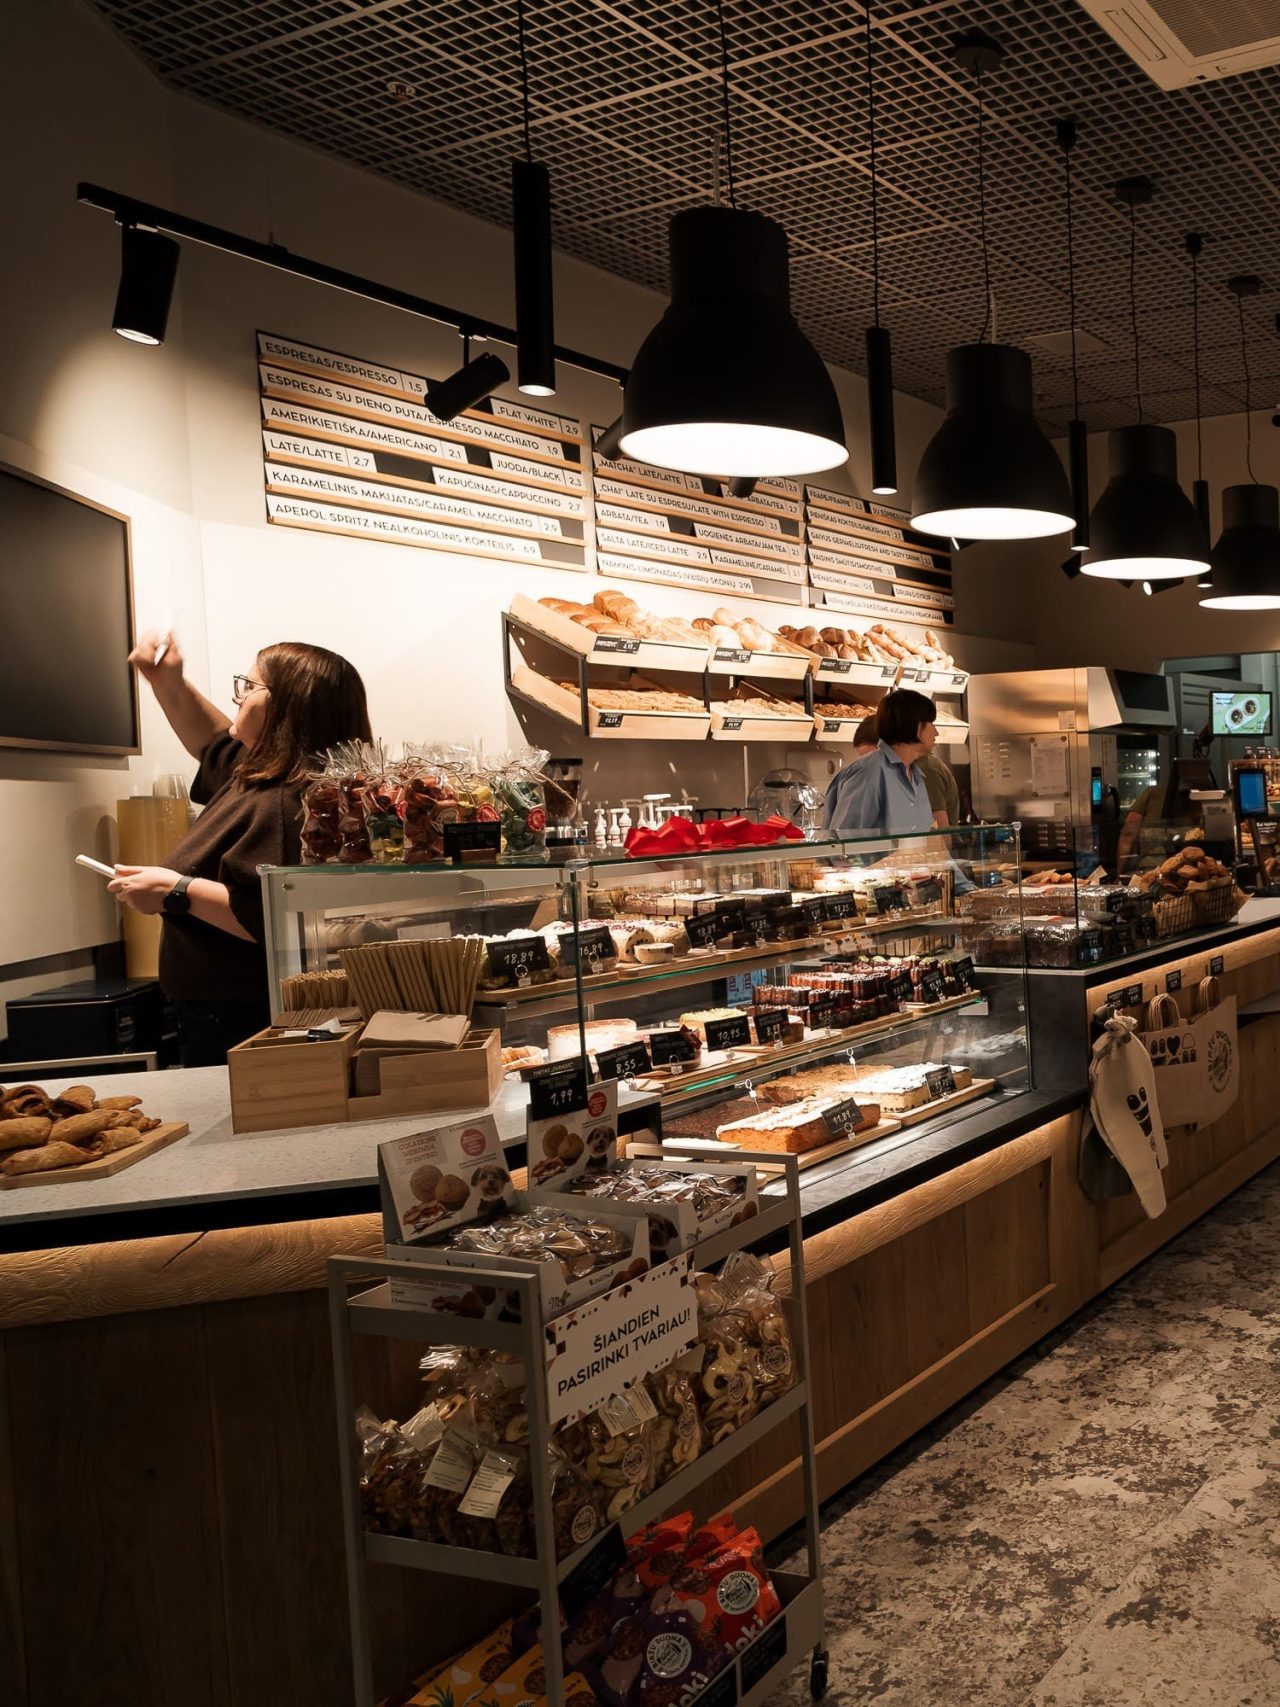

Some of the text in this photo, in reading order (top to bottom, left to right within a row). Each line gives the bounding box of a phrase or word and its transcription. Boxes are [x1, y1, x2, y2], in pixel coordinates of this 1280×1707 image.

[264, 342, 398, 385] ESPRESAS/ESPRESSO
[266, 373, 334, 398] ESPRESAS
[336, 391, 352, 403] SU
[355, 395, 392, 412] PIENO
[484, 429, 540, 450] MACCHIATO
[497, 458, 562, 483] JUODA/BLACK
[272, 471, 358, 496] KARAMELINIS
[275, 504, 328, 521] APEROL
[329, 512, 370, 527] SPRITZ
[503, 951, 535, 966] 18,89
[615, 1058, 637, 1075] 8,55
[550, 1088, 574, 1107] 1,99
[593, 1305, 661, 1353] ŠIANDIEN
[556, 1307, 692, 1397] PASIRINKI TVARIAU!
